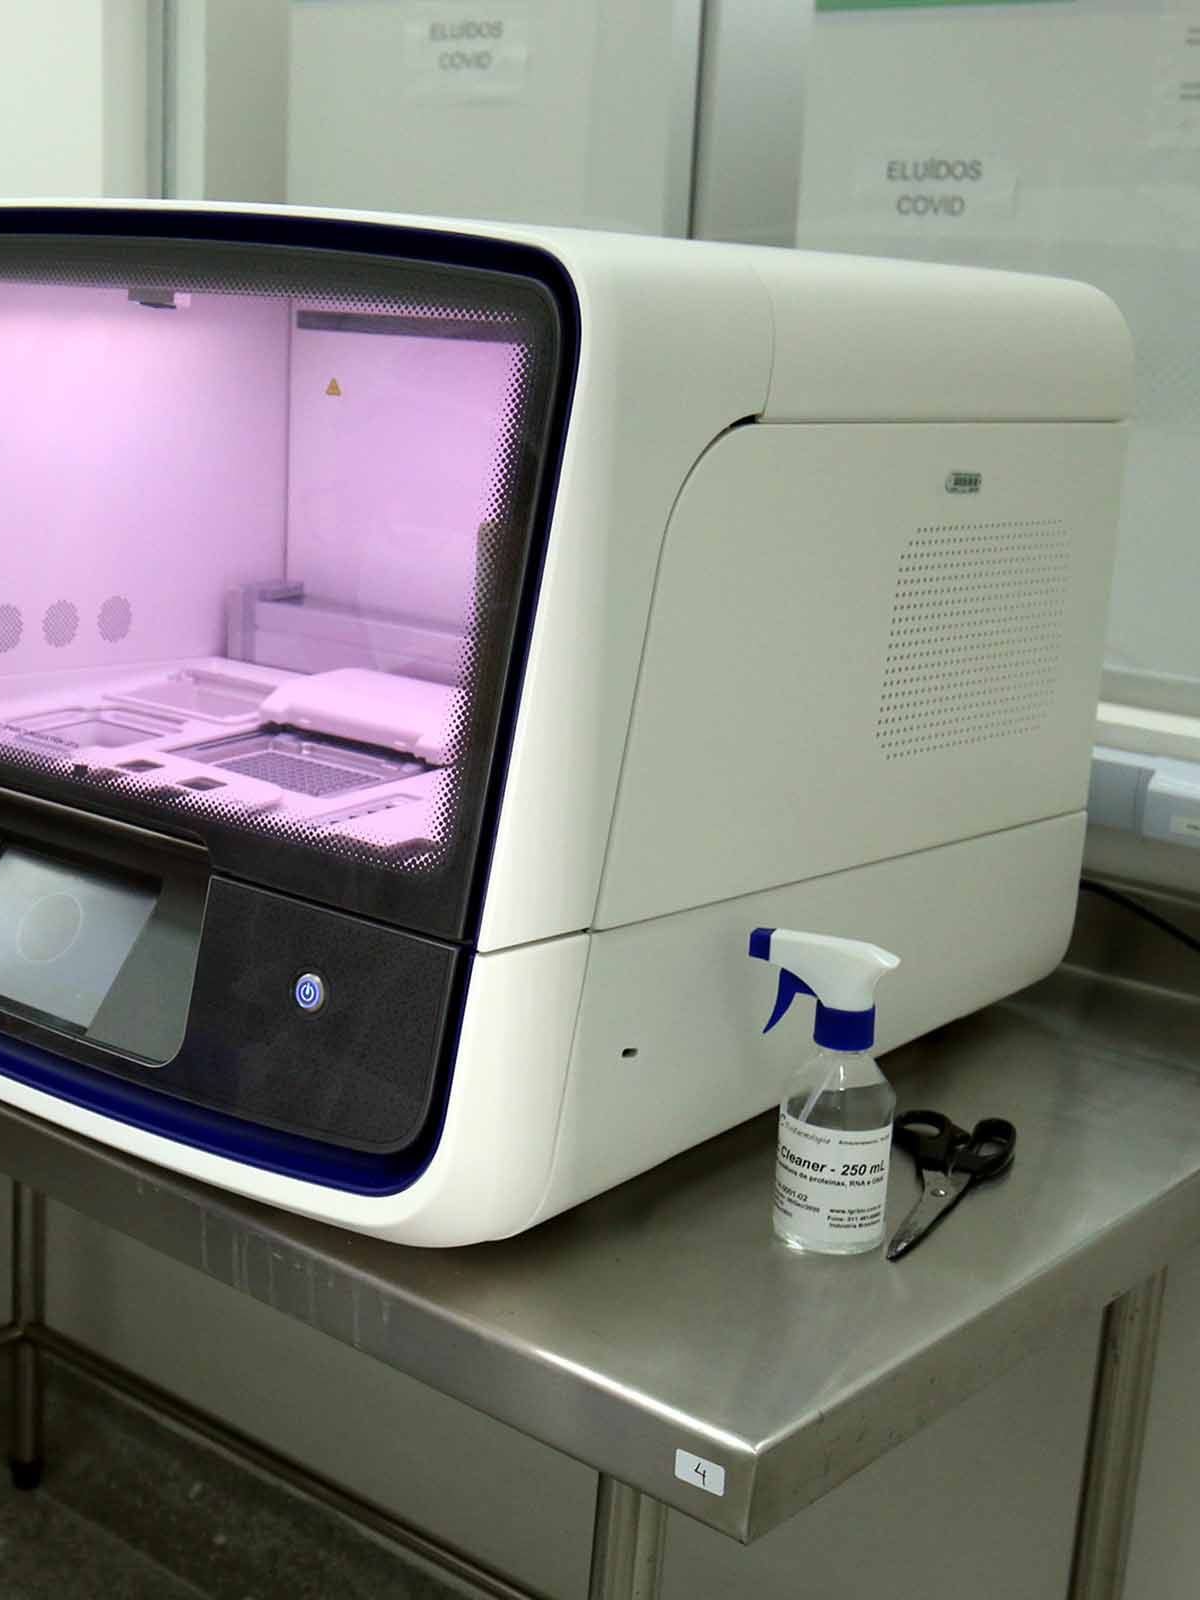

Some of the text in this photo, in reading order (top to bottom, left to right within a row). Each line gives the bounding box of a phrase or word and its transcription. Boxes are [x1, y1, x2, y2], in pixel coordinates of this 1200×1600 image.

[438, 50, 491, 69] COVID
[887, 156, 983, 181] ELUÍDOS
[896, 194, 966, 216] COVID
[781, 1145, 827, 1172] Cleaner
[840, 1163, 867, 1176] 250
[869, 1159, 885, 1174] mL
[694, 1462, 706, 1487] 4
